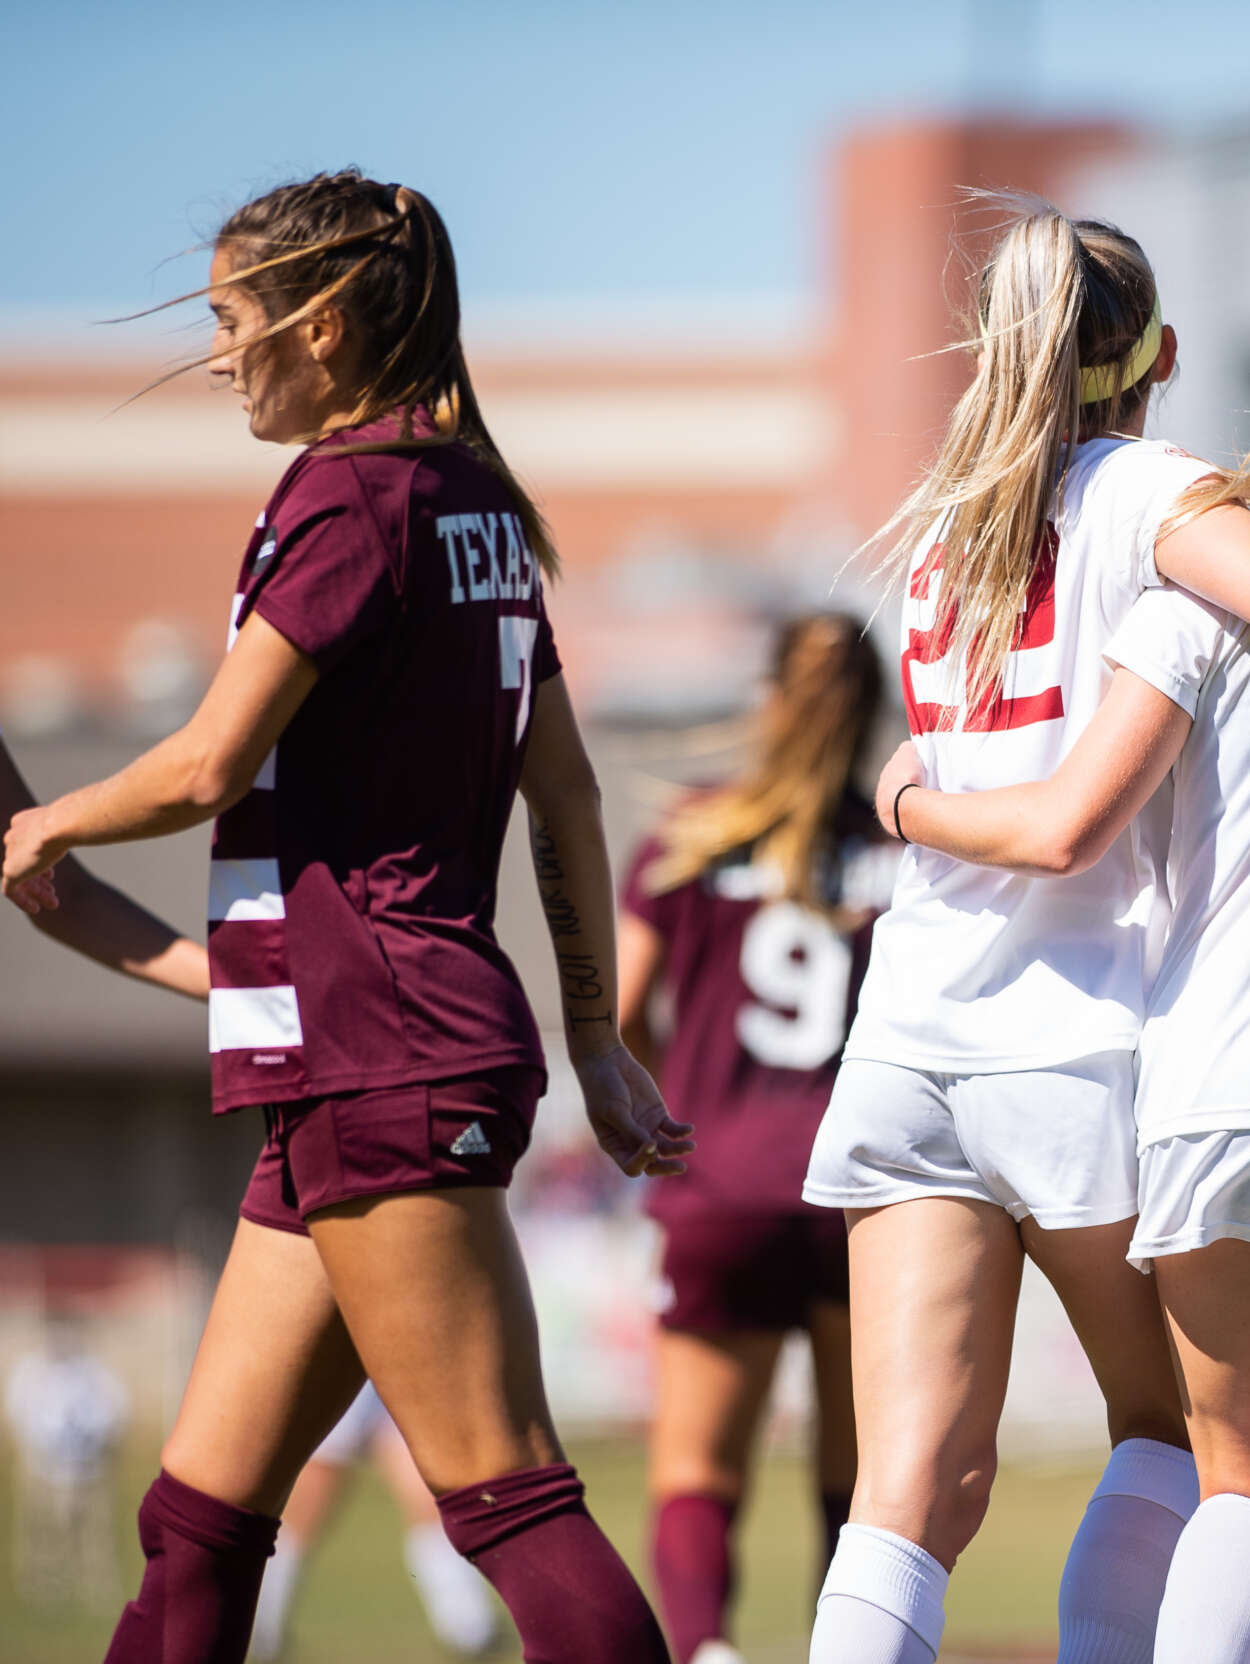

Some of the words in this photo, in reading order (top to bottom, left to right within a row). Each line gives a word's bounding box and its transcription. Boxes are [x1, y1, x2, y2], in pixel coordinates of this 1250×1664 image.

[498, 616, 538, 747] 7
[558, 953, 603, 1001] GOT
[567, 1007, 612, 1033] I
[734, 900, 852, 1071] 9
